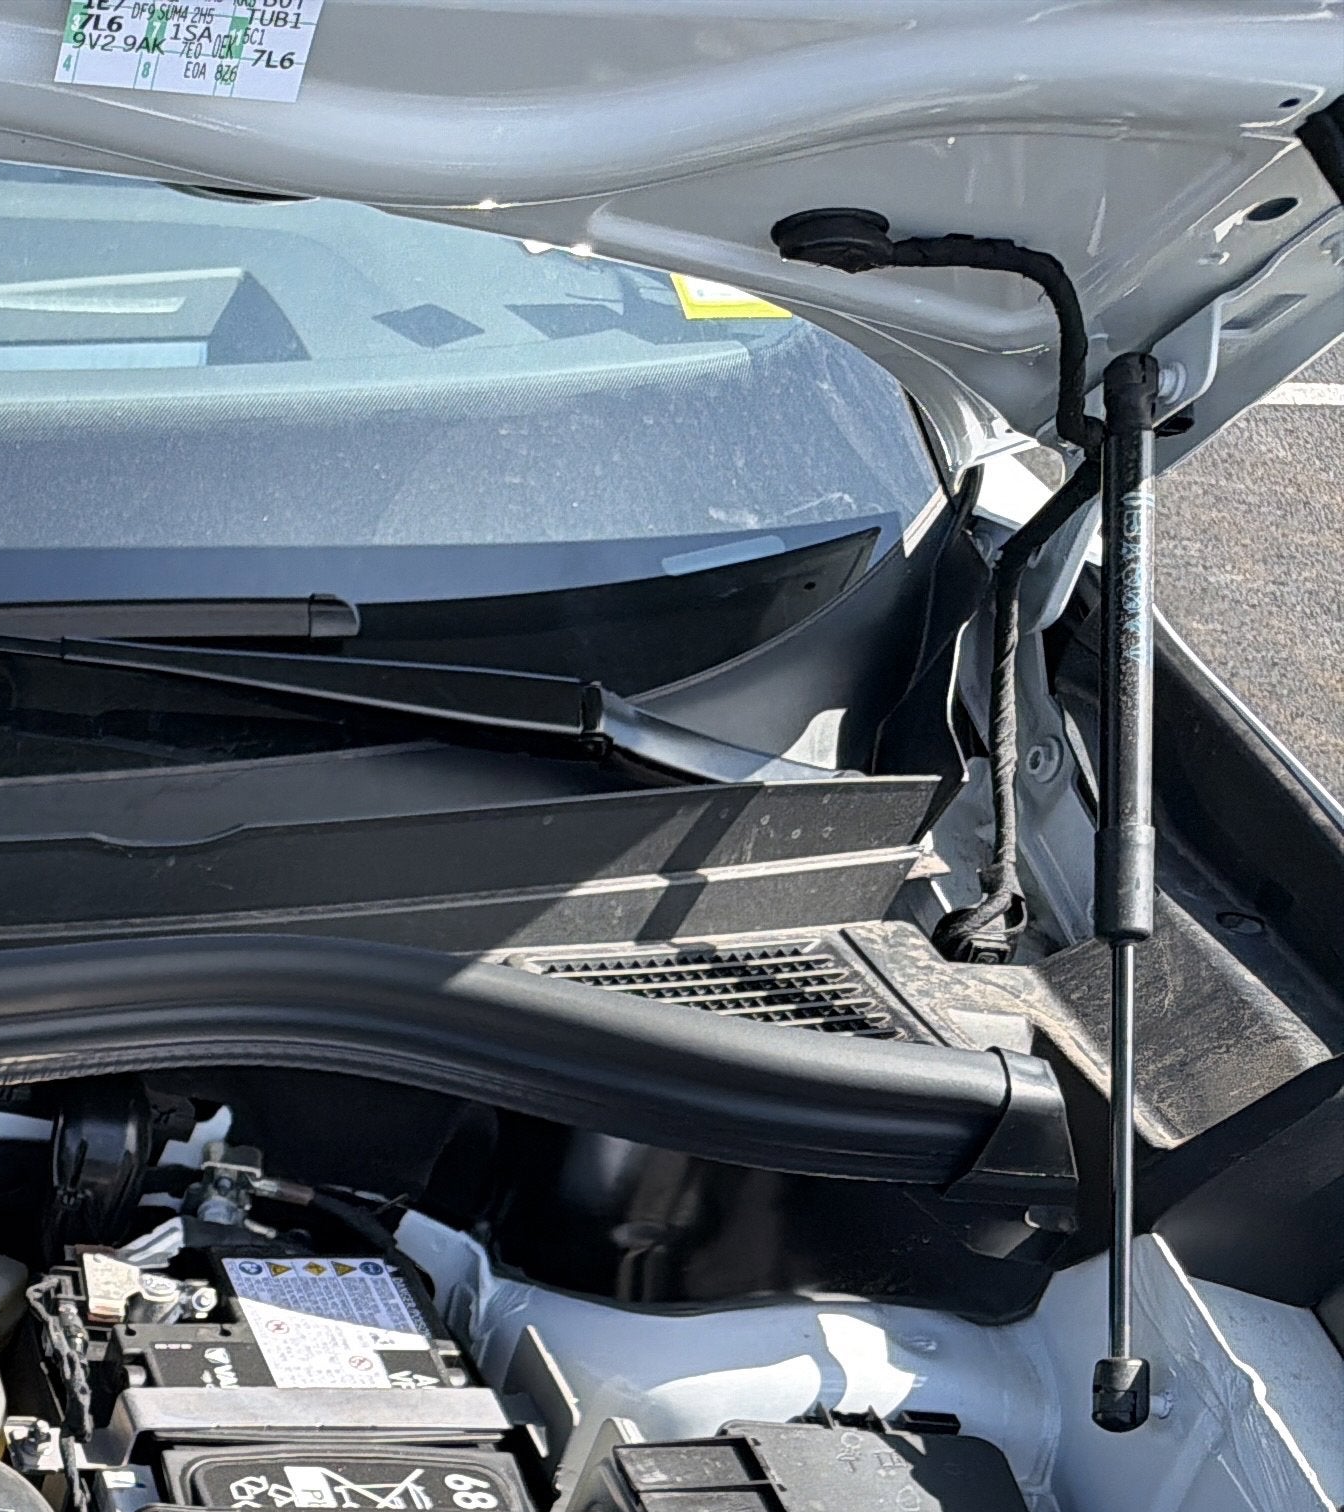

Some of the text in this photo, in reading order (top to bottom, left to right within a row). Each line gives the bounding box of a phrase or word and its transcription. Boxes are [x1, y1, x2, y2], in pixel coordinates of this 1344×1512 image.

[79, 12, 124, 33] 7L6
[169, 23, 212, 42] 1SA
[72, 31, 167, 55] 9V2 9AK
[63, 54, 72, 71] 4
[251, 49, 296, 69] 7L6
[141, 62, 151, 78] 8
